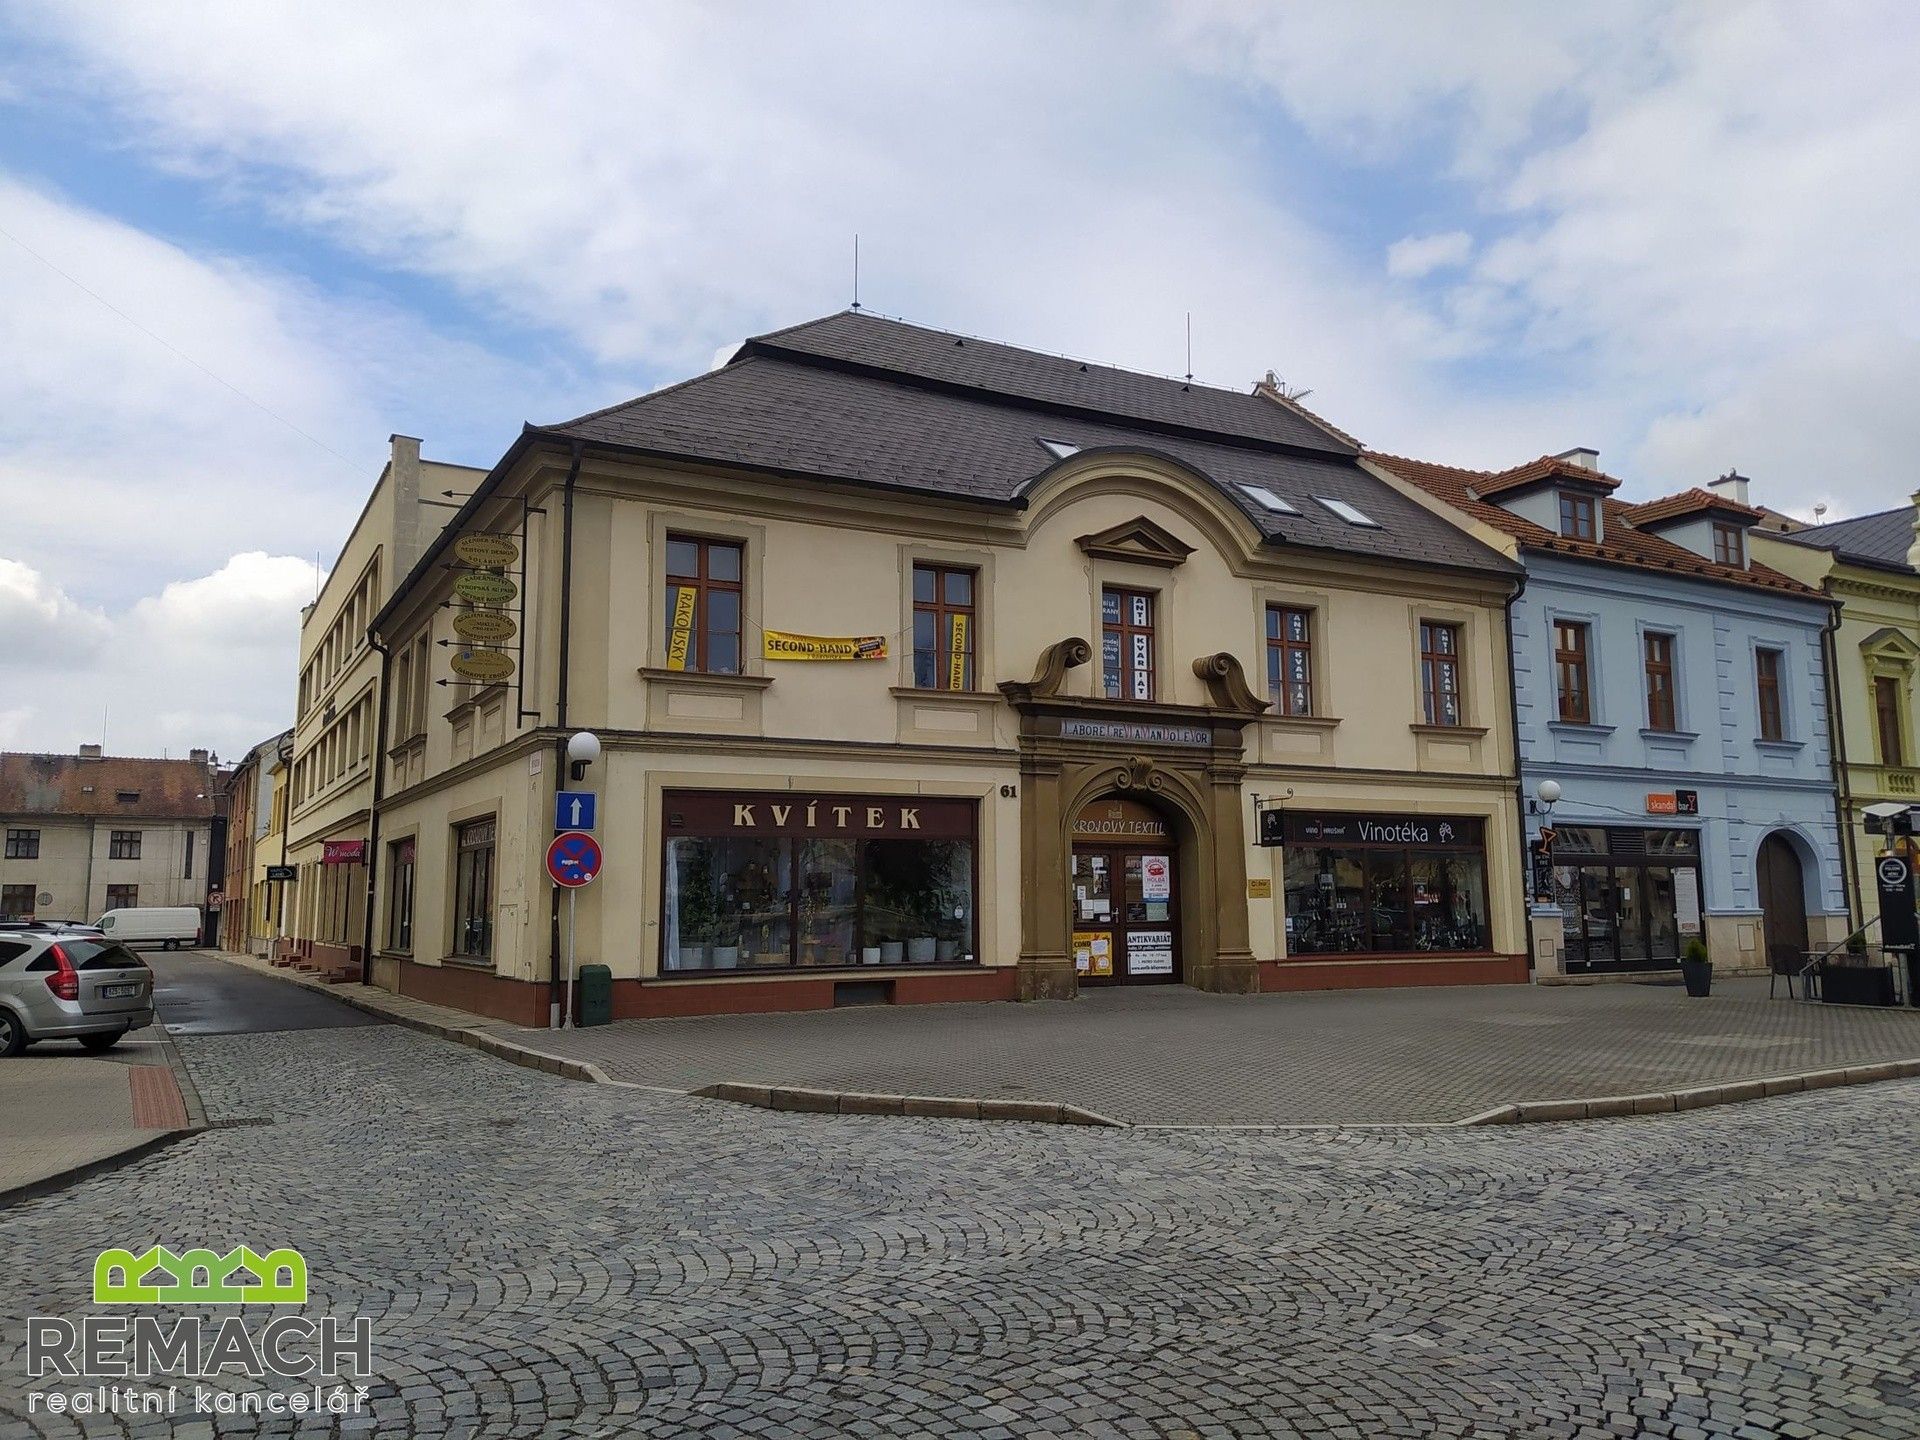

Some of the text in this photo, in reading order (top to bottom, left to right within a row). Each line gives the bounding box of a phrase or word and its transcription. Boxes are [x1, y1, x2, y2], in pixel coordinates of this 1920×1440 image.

[767, 639, 852, 655] SECOND-HAND
[952, 622, 964, 689] SECOND-HAND
[1000, 785, 1017, 798] 61
[1678, 802, 1690, 811] bar
[733, 799, 921, 830] KVÍTEK
[1358, 820, 1429, 843] Vinotéka
[1074, 940, 1091, 948] COND
[1127, 934, 1171, 943] ANTIKVARIÁT
